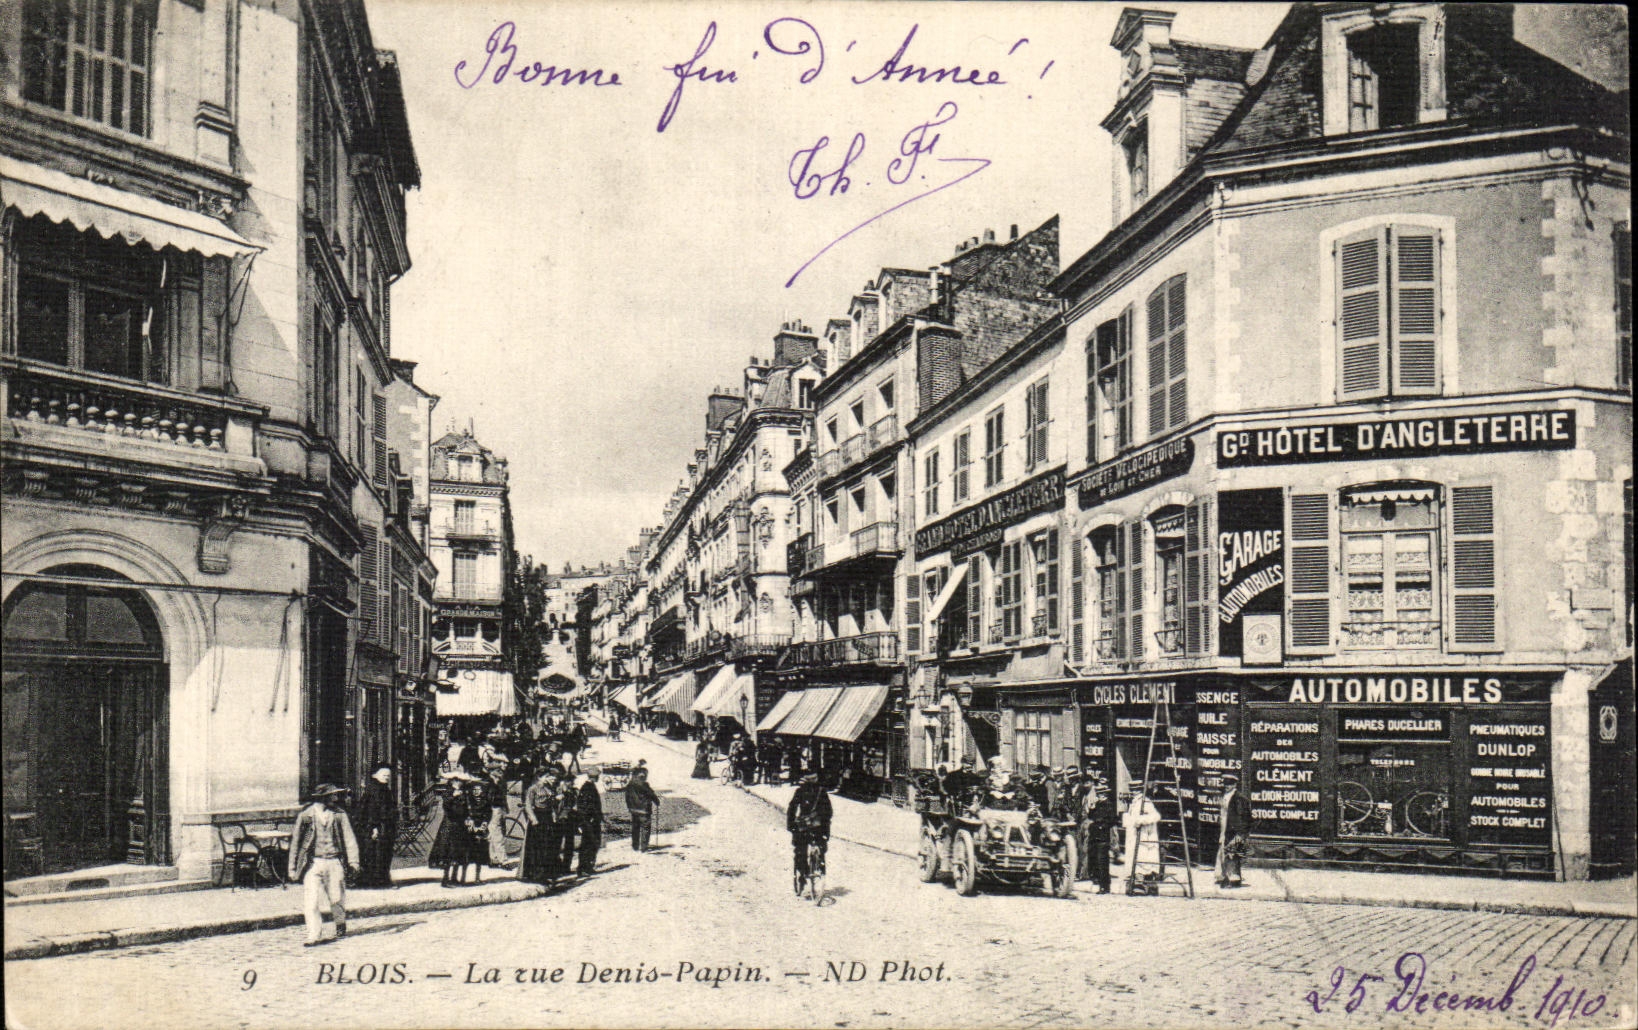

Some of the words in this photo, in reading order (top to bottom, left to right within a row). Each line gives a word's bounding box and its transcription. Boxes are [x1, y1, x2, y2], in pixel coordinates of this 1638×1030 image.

[456, 21, 622, 88] Bonne
[655, 21, 758, 132] fin
[1257, 425, 1342, 456] HÔTEL
[1357, 412, 1569, 451] D'ANGLETERRE
[1219, 529, 1283, 586] GARAGE
[1094, 683, 1126, 705] CYCLES
[1289, 678, 1502, 704] AUTOMOBILES
[1251, 720, 1319, 733] RÉPARATIONS
[1344, 718, 1385, 732] PHARES
[1387, 718, 1443, 732] DUCELLIER
[1470, 724, 1546, 737] PNEUMATIQUES
[1251, 751, 1319, 763] AUTOMOBILES
[1477, 743, 1536, 758] DUNLOP
[1495, 782, 1520, 791] POUR
[1471, 796, 1546, 808] AUTOMOBILES
[1251, 808, 1277, 820] STOCK
[1279, 809, 1320, 821] COMPLET
[1470, 815, 1500, 827] STOCK
[1502, 815, 1546, 829] COMPLET
